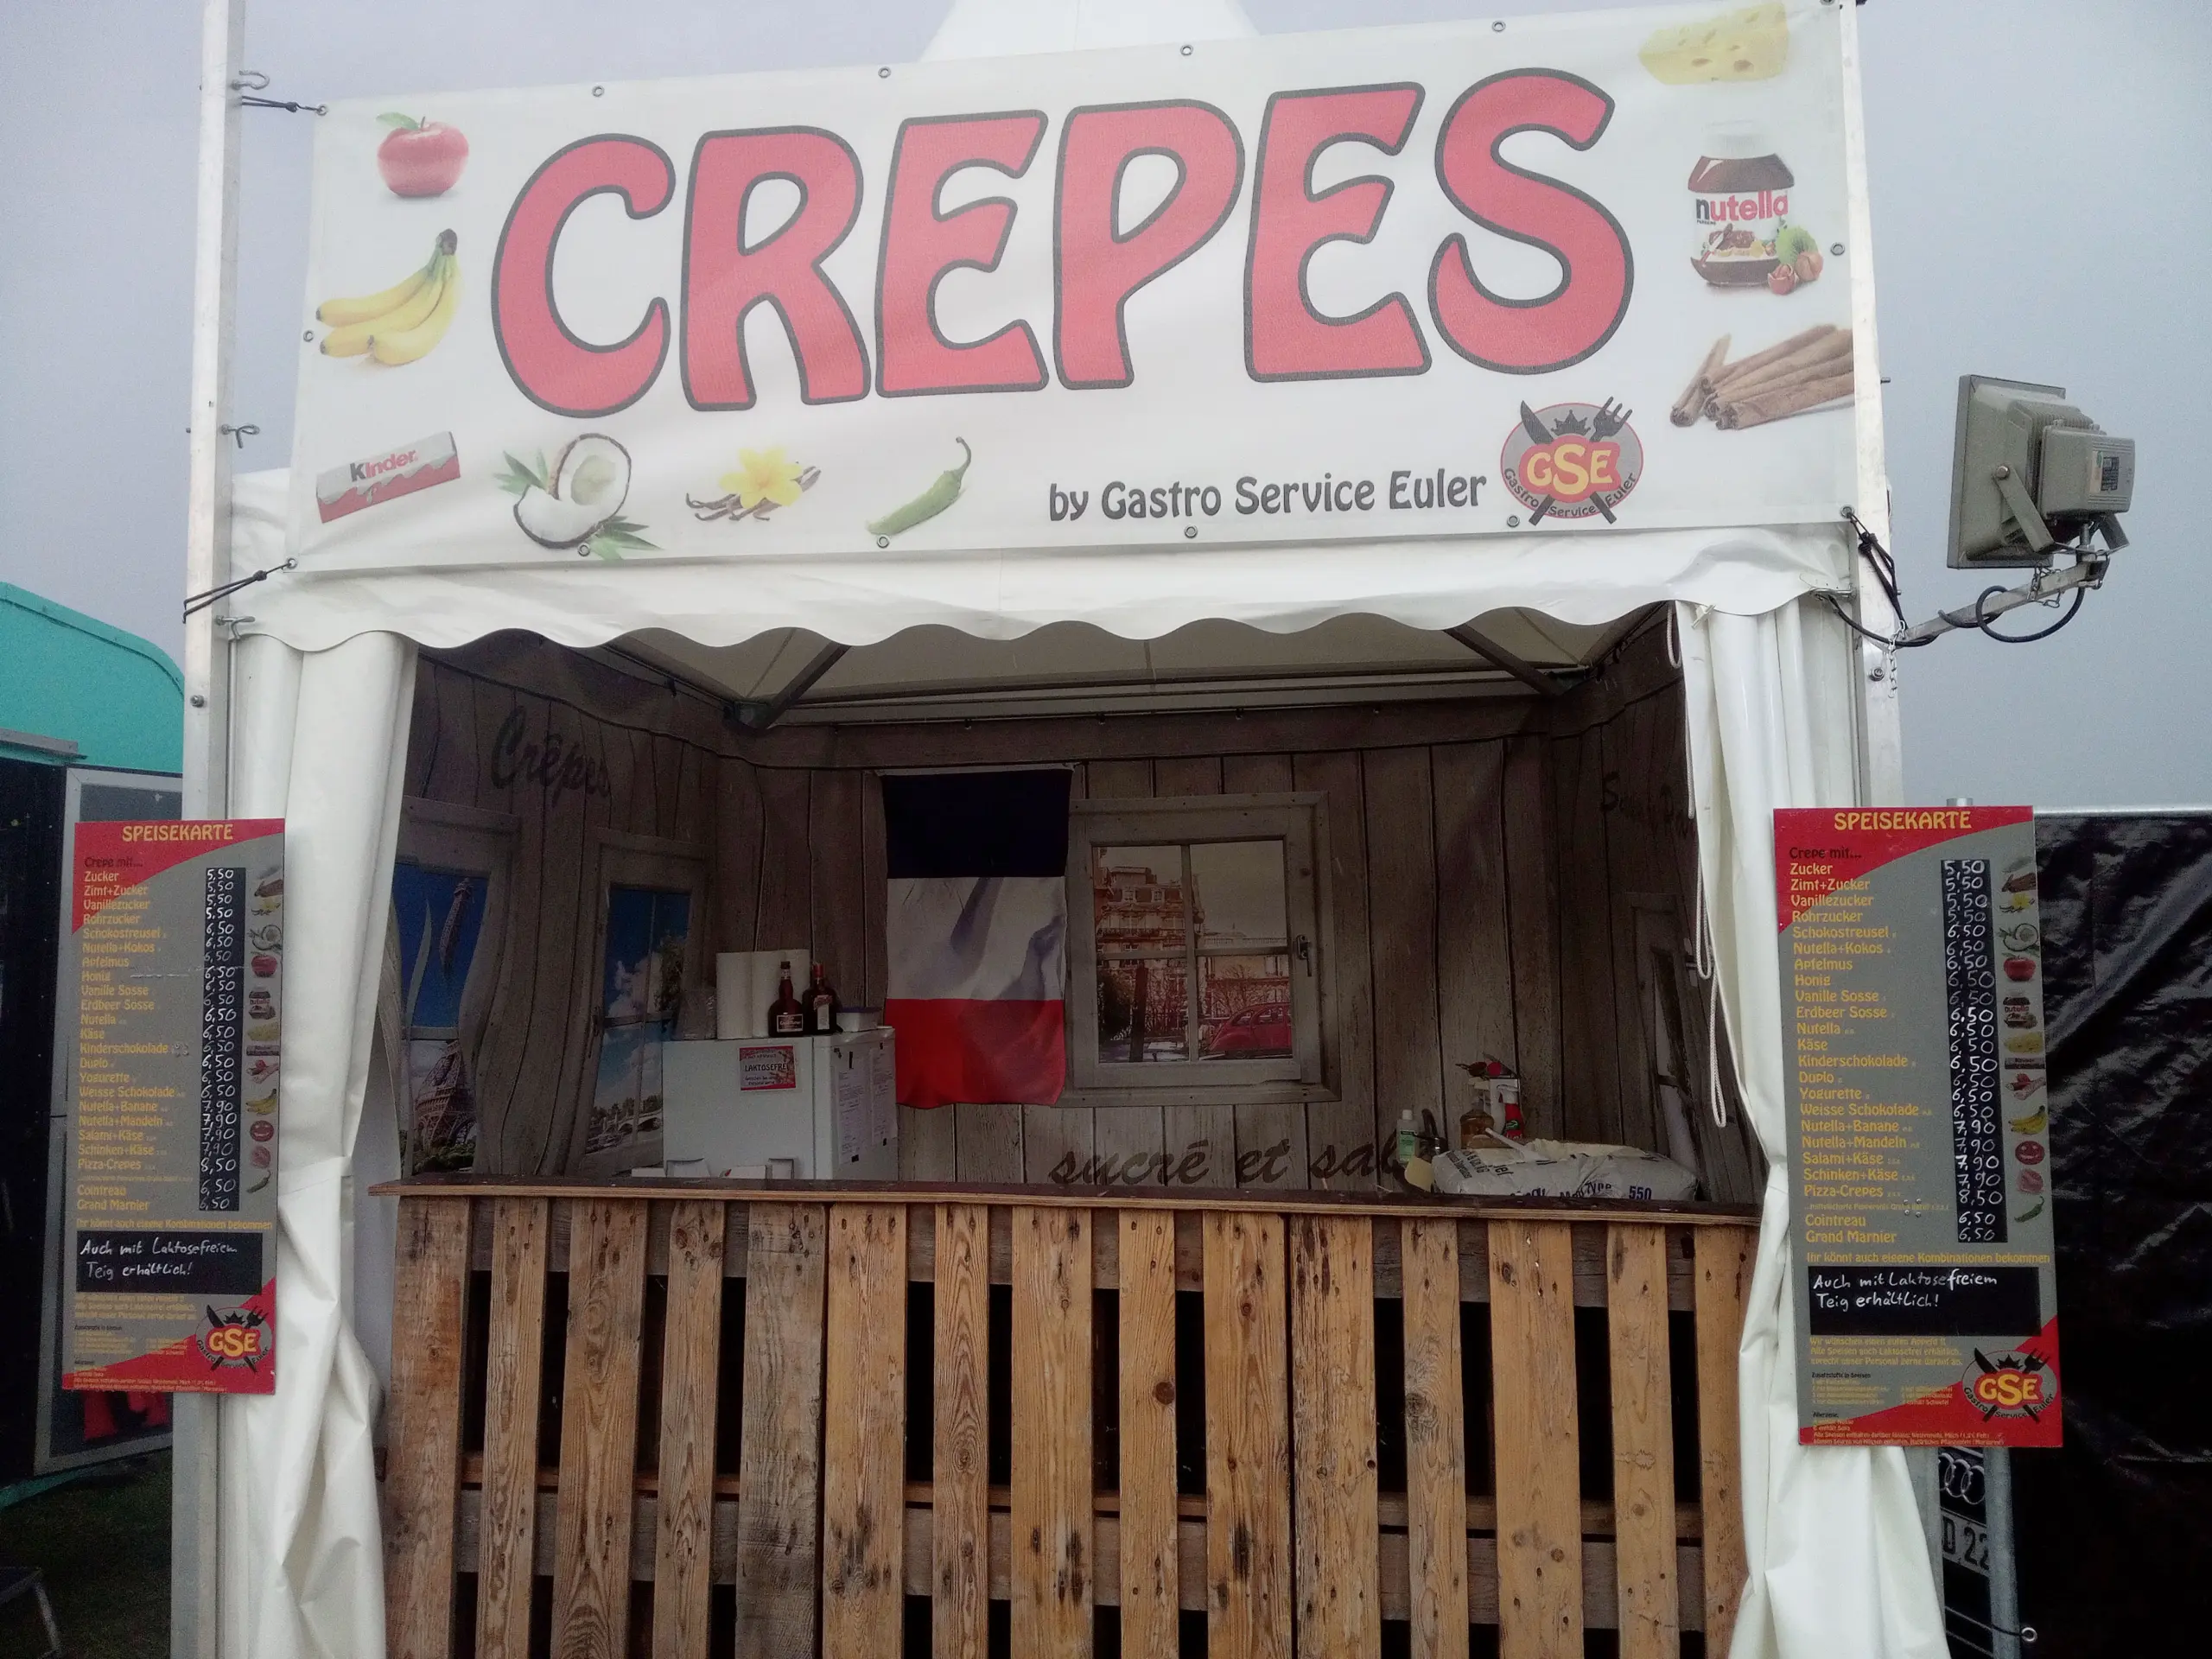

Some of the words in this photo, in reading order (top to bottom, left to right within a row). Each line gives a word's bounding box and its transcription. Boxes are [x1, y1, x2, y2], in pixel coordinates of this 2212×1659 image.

[1695, 190, 1789, 221] nutella
[492, 67, 1634, 418] CREPES
[1527, 443, 1613, 495] GSE
[1050, 483, 1089, 521] by
[1101, 480, 1221, 519] Gastro
[1235, 472, 1376, 515] Service
[1389, 467, 1487, 510] Euler
[1504, 467, 1539, 507] Gastro
[1548, 505, 1596, 518] Service
[1605, 473, 1637, 507] Euler
[1834, 810, 1972, 830] SPEISEKARTE
[122, 823, 234, 842] SPEISEKARTE
[1789, 847, 1826, 860] Crepe
[207, 868, 234, 880] 5,50
[1789, 863, 1834, 875] Zucker
[1944, 860, 1985, 880] 5,50
[84, 871, 119, 882] Zucker
[84, 885, 149, 896] Zimt+Zucker
[207, 880, 234, 893] 5,50
[1790, 879, 1870, 891] Zimt+Zucker
[1945, 876, 1984, 893] 5,50
[83, 899, 150, 910] Vanillezucker
[207, 893, 232, 906] 5,50
[1791, 894, 1874, 907] Vanillezucker
[1947, 893, 1987, 911] 5,50
[83, 913, 140, 925] Rohrzucker
[206, 907, 233, 919] 5,50
[1792, 910, 1863, 923] Rohrzucker
[82, 928, 161, 938] Schokostreusel
[207, 921, 234, 936] 6,50
[1793, 926, 1890, 938] Schokostreusel
[1948, 925, 1986, 938] 6,50
[82, 943, 155, 953] Nutella+Kokos
[206, 936, 233, 949] 6,50
[1793, 942, 1883, 955] Nutella+Kokos
[1946, 940, 1985, 957] 6,50
[82, 957, 130, 968] Apfelmus
[1794, 958, 1853, 971] Apfelmus
[1947, 954, 1987, 970] 6,50
[205, 966, 235, 981] 6,50
[1948, 969, 1994, 988] 6,50
[205, 980, 235, 992] 6,50
[1795, 975, 1831, 987] Honig
[81, 985, 115, 996] Vanille
[118, 985, 149, 996] Sosse
[1796, 990, 1837, 1002] Vanille
[1840, 990, 1879, 1002] Sosse
[80, 1000, 121, 1011] Erdbeer
[124, 1000, 155, 1011] Sosse
[205, 1007, 237, 1023] 6,50
[1796, 1006, 1846, 1019] Erdbeer
[1849, 1006, 1888, 1018] Sosse
[1950, 1007, 1993, 1022] 6,50
[80, 1014, 117, 1025] Nutella
[202, 1024, 235, 1040] 6,50
[1796, 1022, 1841, 1035] Nutella
[1949, 1022, 1994, 1037] 6,50
[79, 1042, 168, 1054] Kinderschokolade
[1797, 1039, 1828, 1051] Käse
[1950, 1037, 1994, 1055] 6,50
[202, 1054, 234, 1069] 6,50
[1798, 1054, 1909, 1067] Kinderschokolade
[1950, 1055, 1998, 1072] 6,50
[201, 1069, 234, 1084] 6,50
[1798, 1071, 1834, 1084] Duplo
[1953, 1073, 1995, 1089] 6,50
[79, 1085, 115, 1097] Weisse
[117, 1085, 175, 1097] Schokolade
[200, 1084, 235, 1099] 6,50
[1799, 1087, 1862, 1100] Yogurette
[1952, 1088, 1993, 1103] 6,50
[79, 1101, 158, 1112] Nutella+Banane
[201, 1100, 233, 1113] 7,90
[1800, 1103, 1845, 1116] Weisse
[1848, 1103, 1919, 1116] Schokolade
[1953, 1103, 1993, 1119] 6,50
[79, 1116, 163, 1127] Nutella+Mandeln
[202, 1112, 237, 1128] 7,90
[1801, 1119, 1899, 1132] Nutella+Banane
[1954, 1119, 1996, 1135] 7,90
[78, 1129, 144, 1141] Salami+Käse
[201, 1127, 235, 1141] 7,90
[1802, 1135, 1907, 1148] Nutella+Mandeln
[1955, 1137, 1995, 1154] 7,90
[78, 1144, 155, 1156] Schinken+Käse
[1049, 1140, 1210, 1185] sucré
[1236, 1139, 1290, 1184] et
[1802, 1151, 1884, 1165] Salami+Käse
[1955, 1154, 1999, 1171] 7,90
[200, 1157, 236, 1174] 8,50
[1803, 1167, 1898, 1181] Schinken+Käse
[1957, 1172, 2000, 1189] 7,90
[77, 1185, 126, 1196] Cointreau
[200, 1178, 236, 1195] 6,50
[1629, 1185, 1652, 1200] 550
[1804, 1184, 1884, 1197] Pizza-Crepes
[1959, 1189, 2003, 1206] 8,50
[77, 1198, 107, 1211] Grand
[110, 1198, 150, 1211] Marnier
[1805, 1214, 1866, 1227] Cointreau
[1959, 1211, 1996, 1225] 6,50
[1806, 1230, 1843, 1243] Grand
[1847, 1230, 1898, 1243] Marnier
[1959, 1227, 1995, 1242] 6,50
[79, 1239, 112, 1255] Auch
[119, 1240, 143, 1255] mit
[1807, 1252, 1821, 1262] Ihr
[1824, 1251, 1853, 1262] könnt
[1855, 1252, 1879, 1263] auch
[1918, 1251, 1993, 1263] Kombinationen
[1995, 1251, 2050, 1263] bekommen
[86, 1262, 114, 1280] Teig
[123, 1262, 194, 1278] erhältlich!
[1813, 1274, 1851, 1290] Auch
[1859, 1274, 1885, 1286] mit
[1816, 1293, 1849, 1312] Teig
[1856, 1291, 1939, 1308] erhältlich!
[208, 1327, 257, 1357] GSE
[1979, 1373, 2040, 1406] GSE
[1963, 1387, 1989, 1412] Gastro
[1994, 1408, 2029, 1419] Service
[2032, 1393, 2054, 1414] Euler
